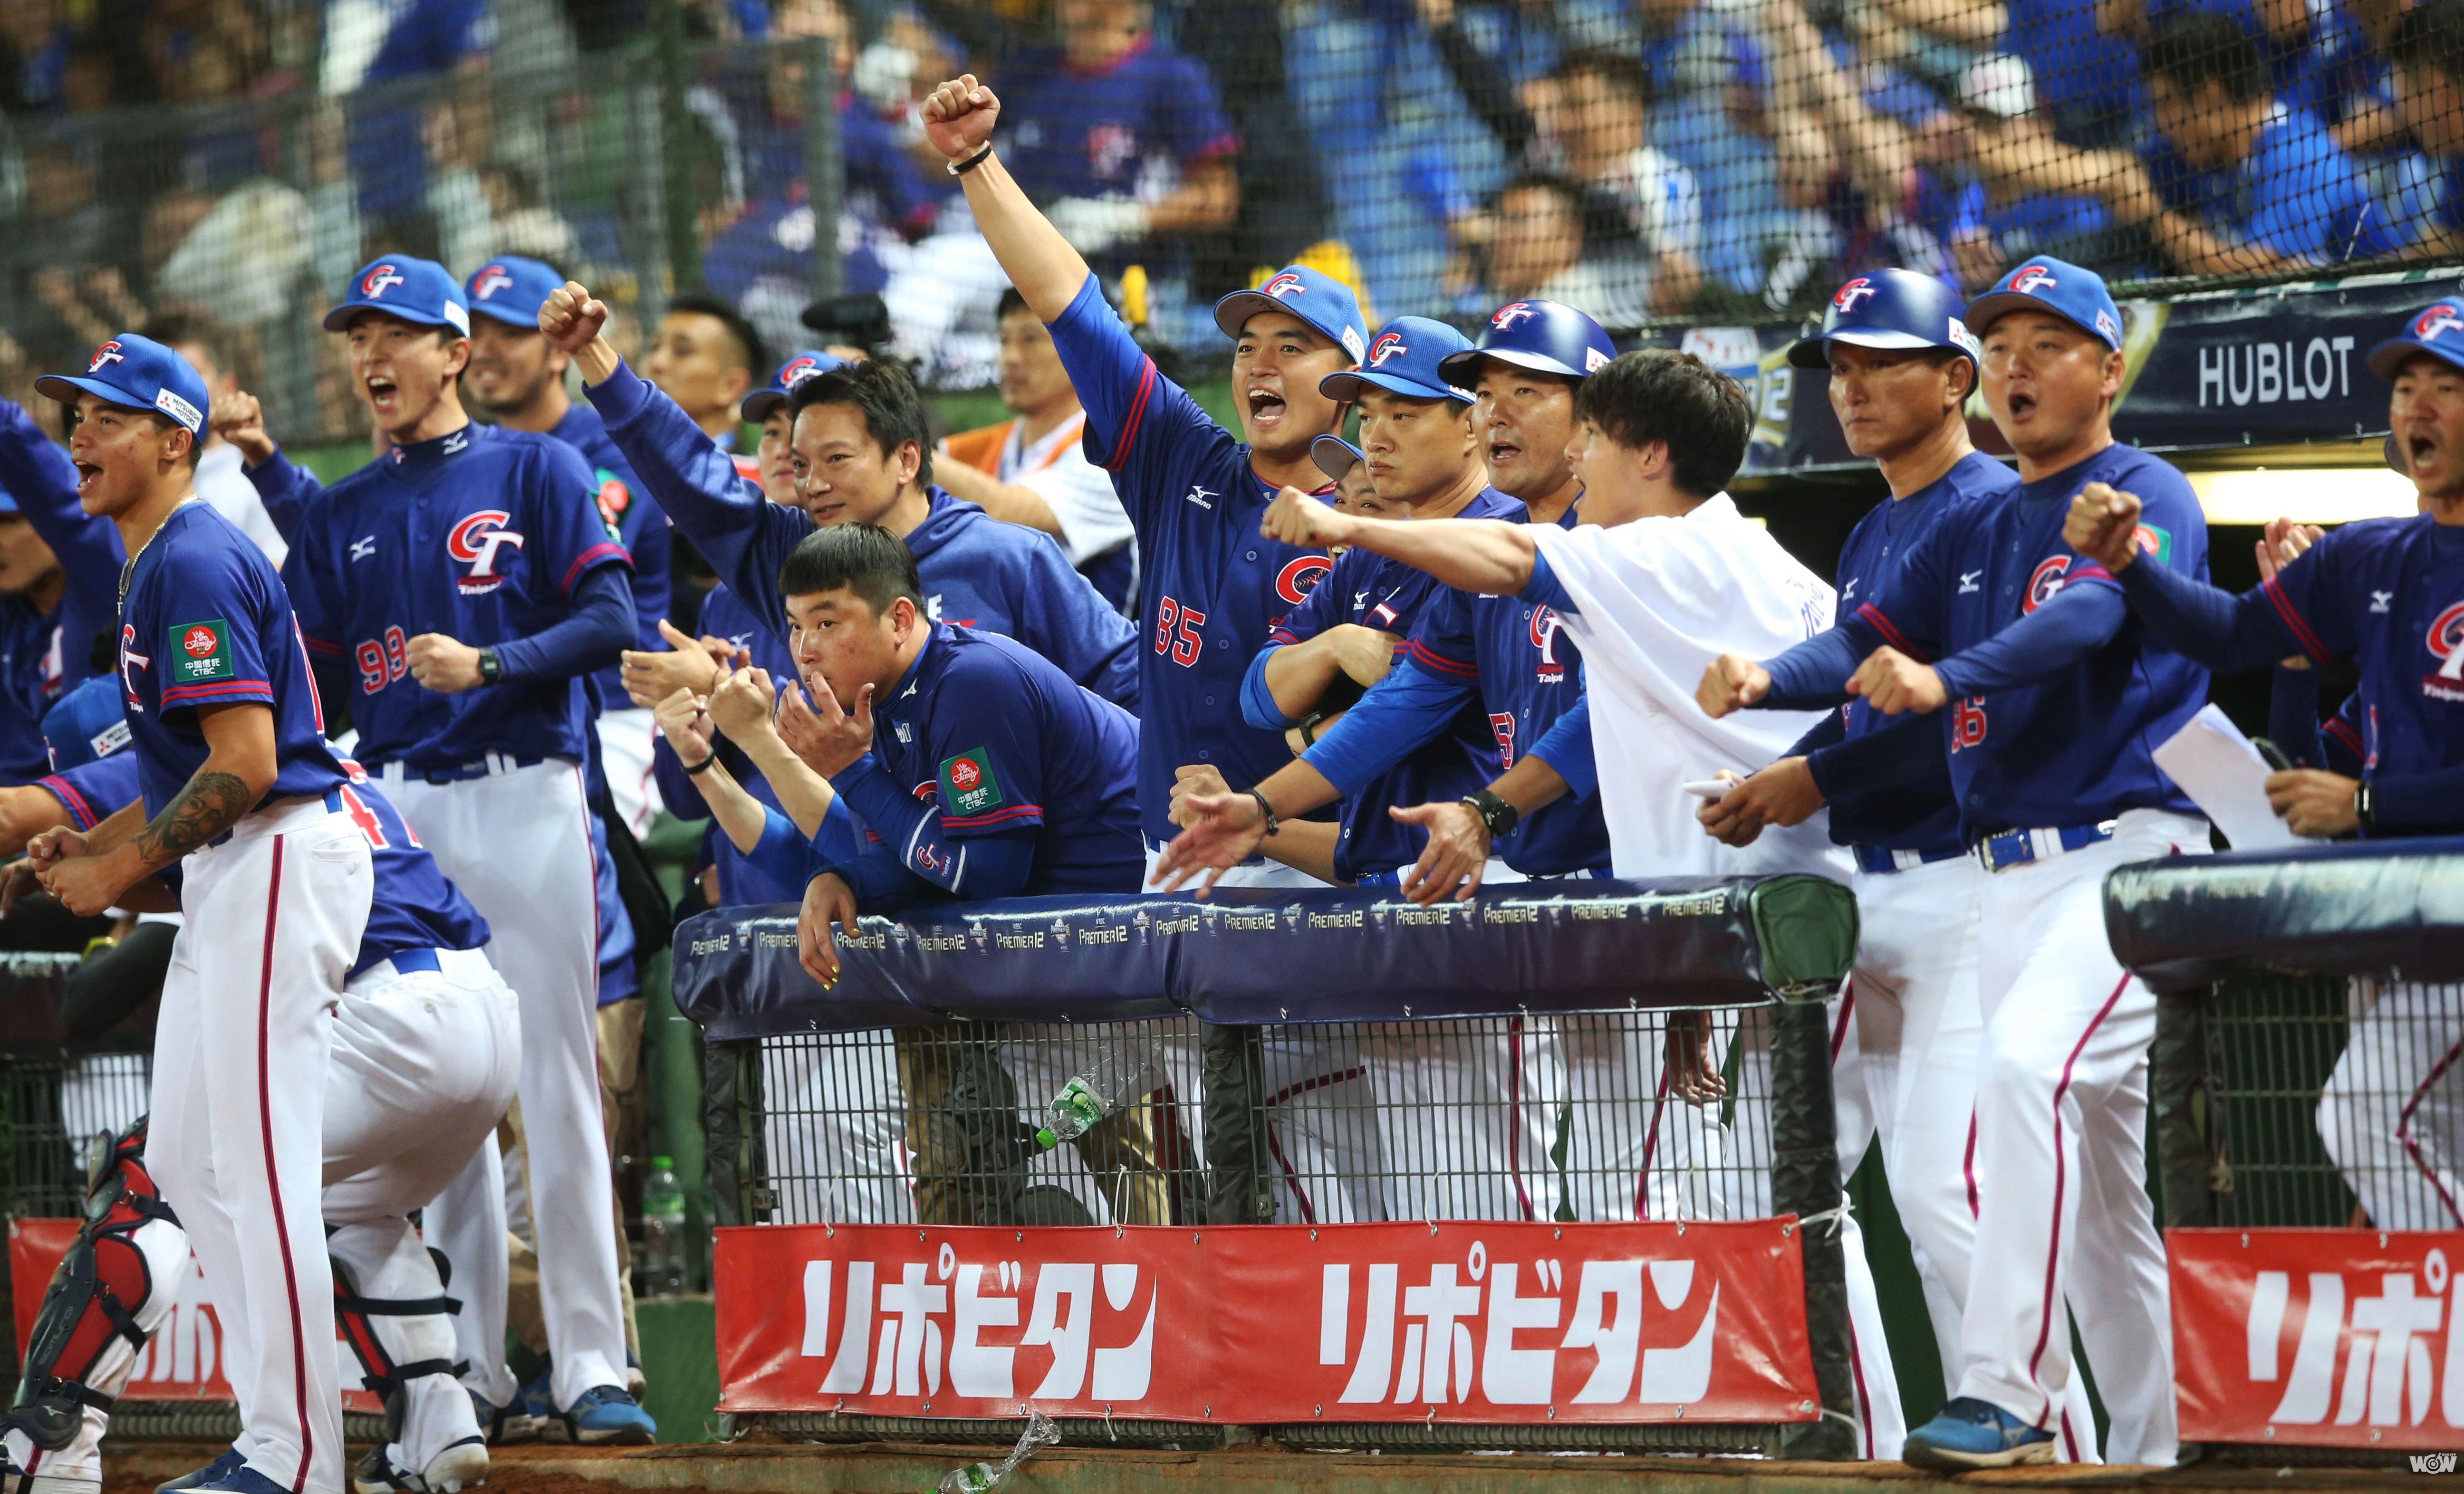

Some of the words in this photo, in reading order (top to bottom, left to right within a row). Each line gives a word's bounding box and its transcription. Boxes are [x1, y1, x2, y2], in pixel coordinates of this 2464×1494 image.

[2199, 336, 2354, 407] HUBLOT
[173, 398, 200, 422] MITSUBISHI
[175, 407, 195, 426] MOTORS
[1186, 494, 1212, 509] MIZUNO
[1155, 595, 1206, 668] 85
[192, 667, 215, 676] CTBC
[356, 624, 408, 695] 99
[953, 766, 979, 783] Family
[956, 763, 967, 771] We
[958, 787, 988, 804] 中國信託
[966, 797, 985, 809] CTBC
[996, 931, 1044, 949] PREMIER12
[1078, 925, 1128, 945] PREMIER12
[1224, 913, 1276, 931] PREMIER12
[1308, 910, 1363, 929] PREMIER12
[1396, 908, 1451, 925] PREMIER12
[1484, 905, 1538, 923] PREMIER12
[801, 1242, 1156, 1401] リポビタン
[1320, 1239, 1719, 1405] リポビタン
[2247, 1248, 2464, 1427] リポ
